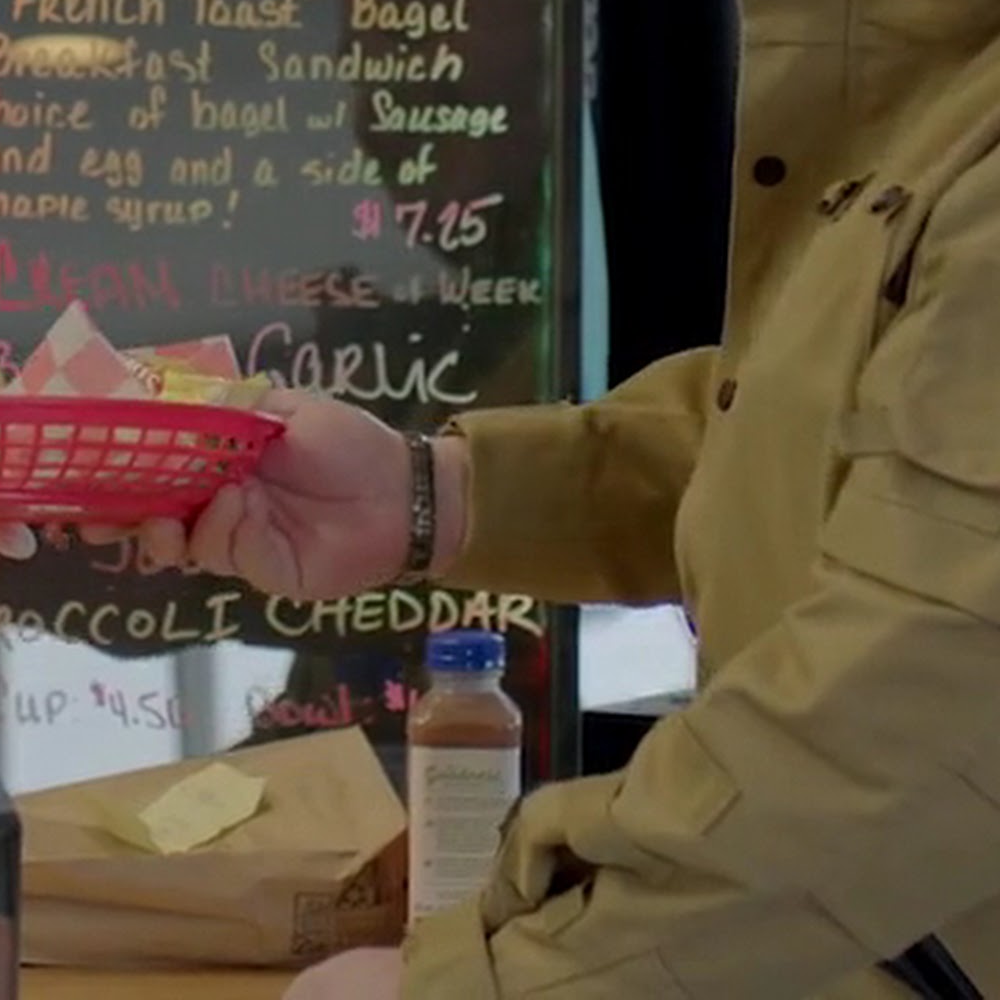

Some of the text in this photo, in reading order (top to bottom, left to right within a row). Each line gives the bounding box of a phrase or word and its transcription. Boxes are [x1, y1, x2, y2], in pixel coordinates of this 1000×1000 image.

[258, 40, 464, 83] Sandwich
[128, 85, 168, 131] of
[190, 89, 289, 138] bagel
[369, 89, 509, 138] Sausage
[79, 148, 144, 188] egg
[170, 146, 234, 185] and
[253, 158, 279, 187] a
[302, 147, 384, 186] side
[397, 143, 438, 185] of
[264, 590, 544, 638] CHEDDAR
